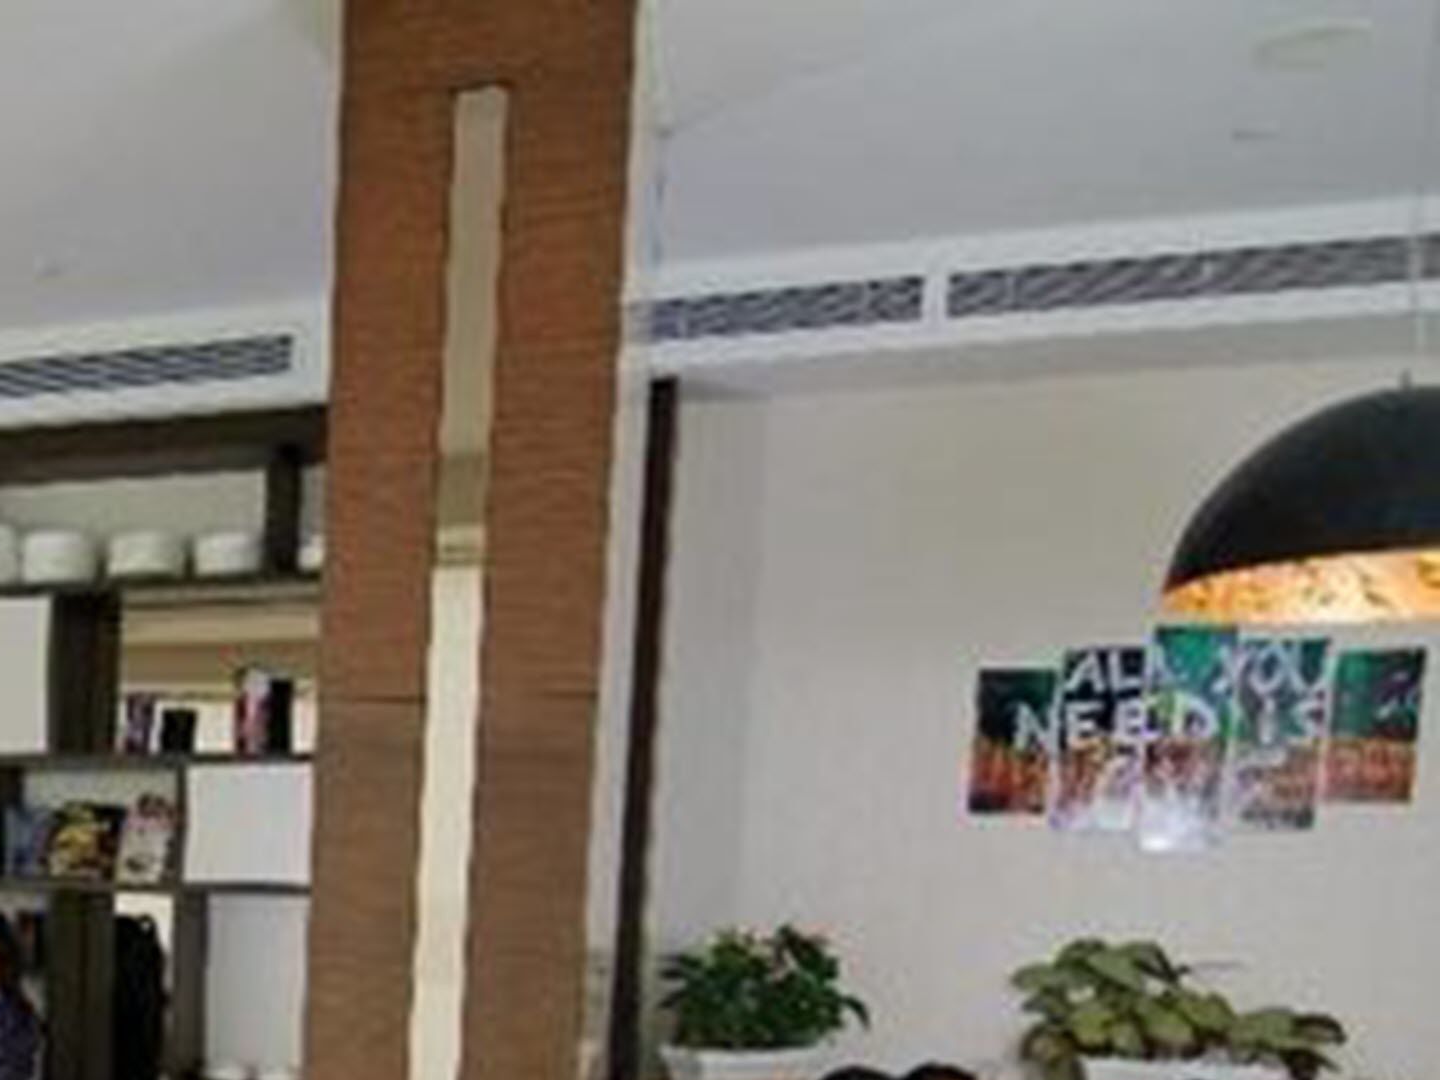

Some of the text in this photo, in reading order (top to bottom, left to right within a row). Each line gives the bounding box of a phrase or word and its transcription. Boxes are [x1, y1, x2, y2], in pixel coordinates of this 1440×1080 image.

[1212, 639, 1329, 696] YOU
[1013, 691, 1329, 754] NEED IS
